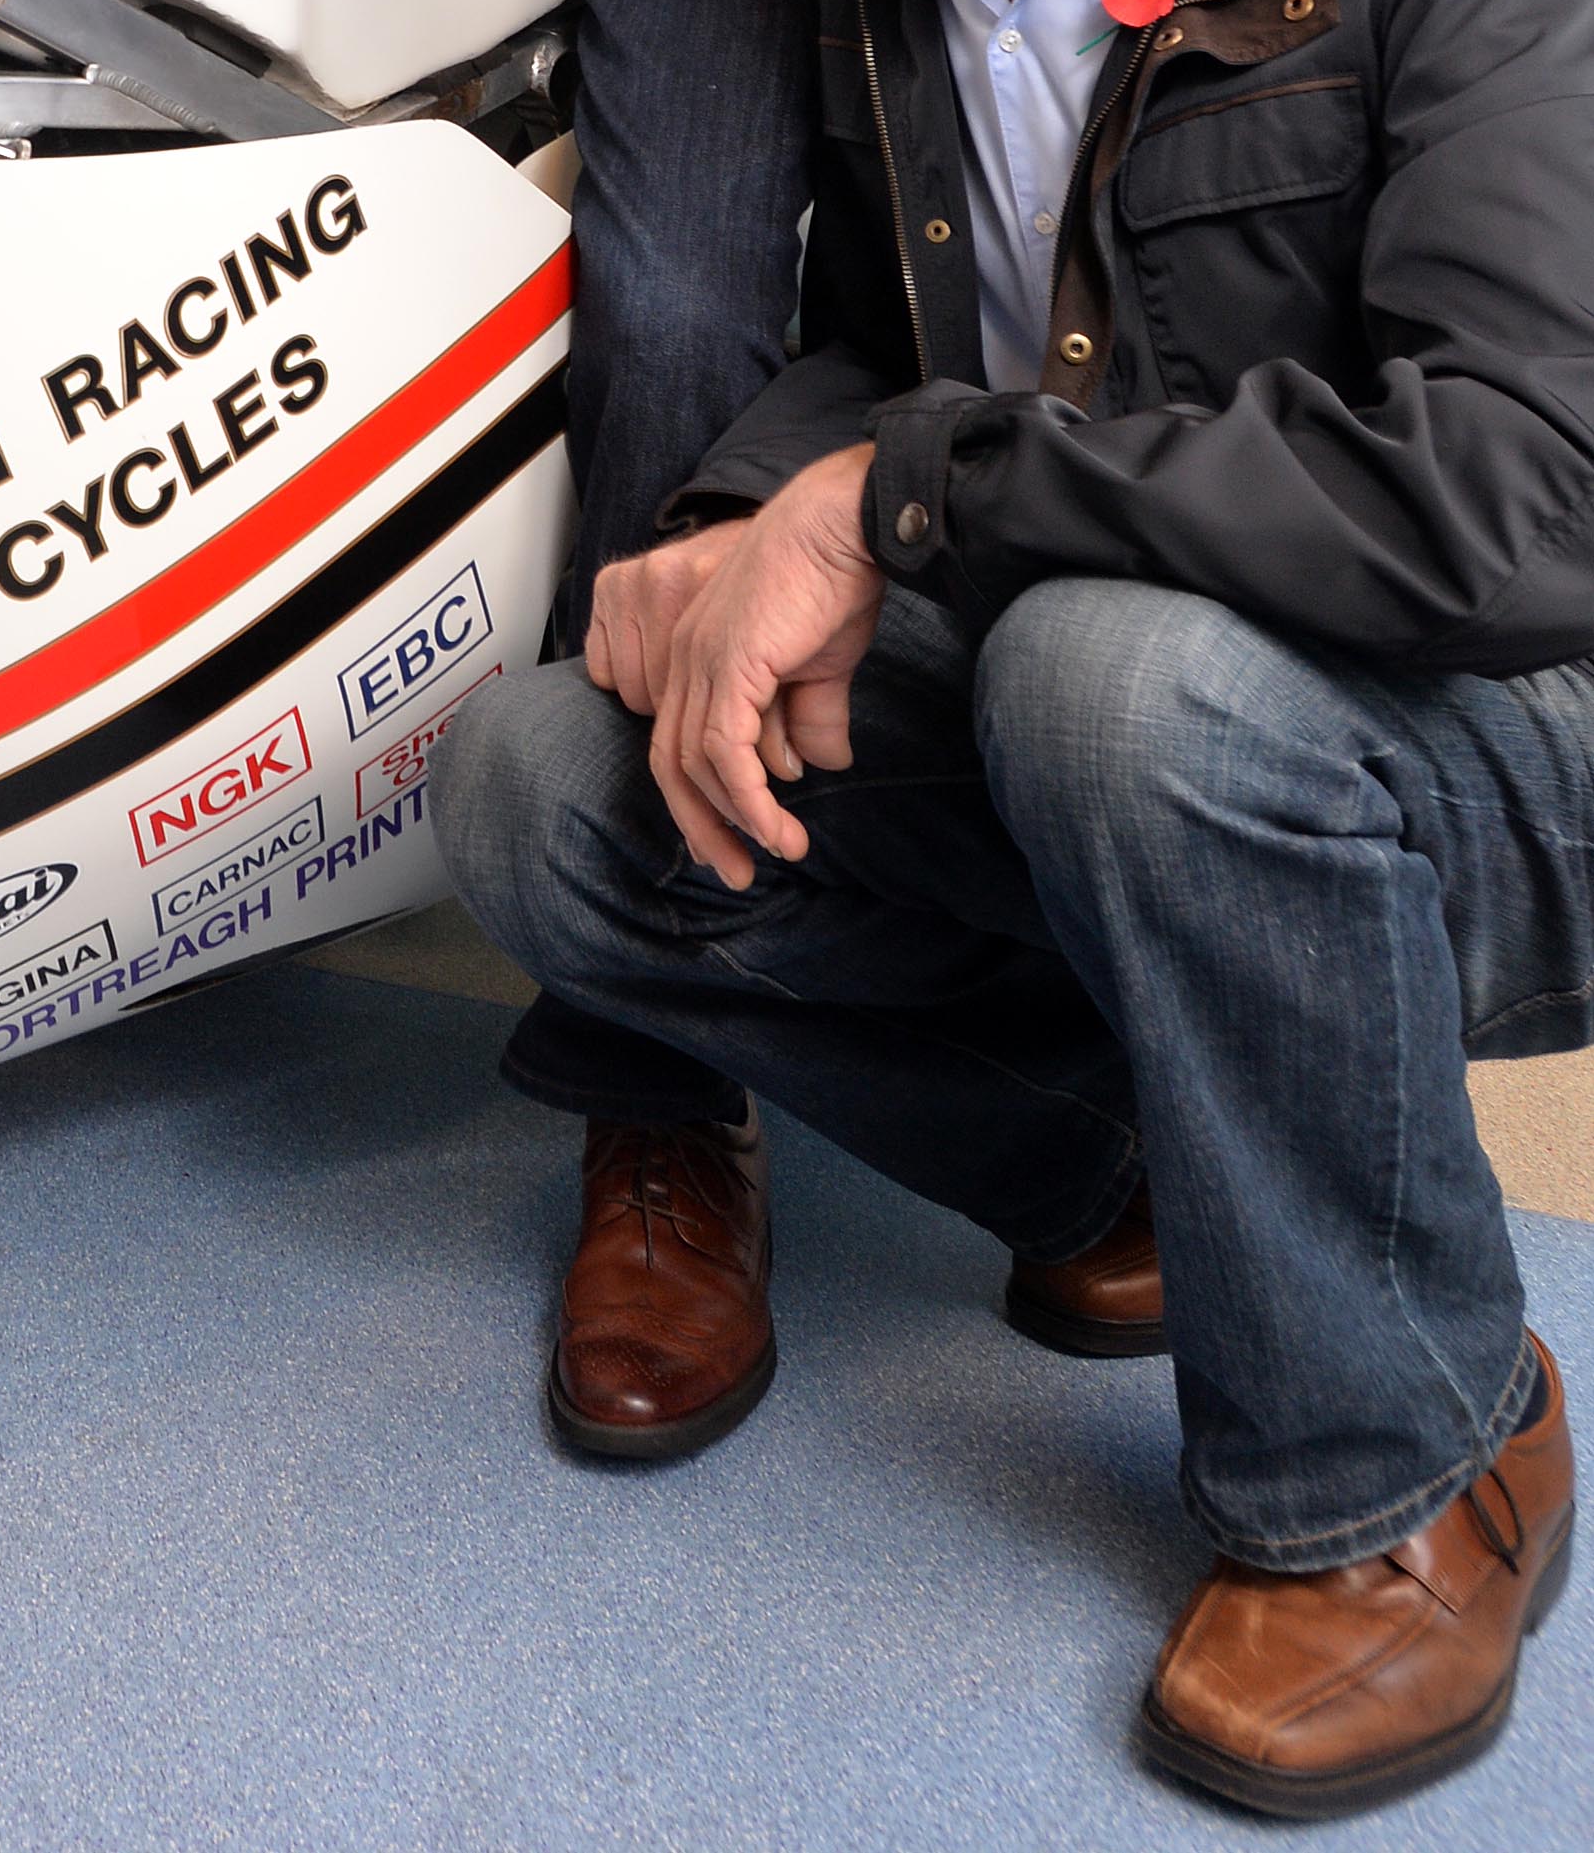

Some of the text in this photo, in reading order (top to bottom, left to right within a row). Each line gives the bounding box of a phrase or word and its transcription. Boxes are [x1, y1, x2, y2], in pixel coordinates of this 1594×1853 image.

[41, 174, 368, 443] RACING
[359, 595, 472, 716] EBC
[149, 734, 293, 848] NGK
[167, 818, 311, 917] CARNAC
